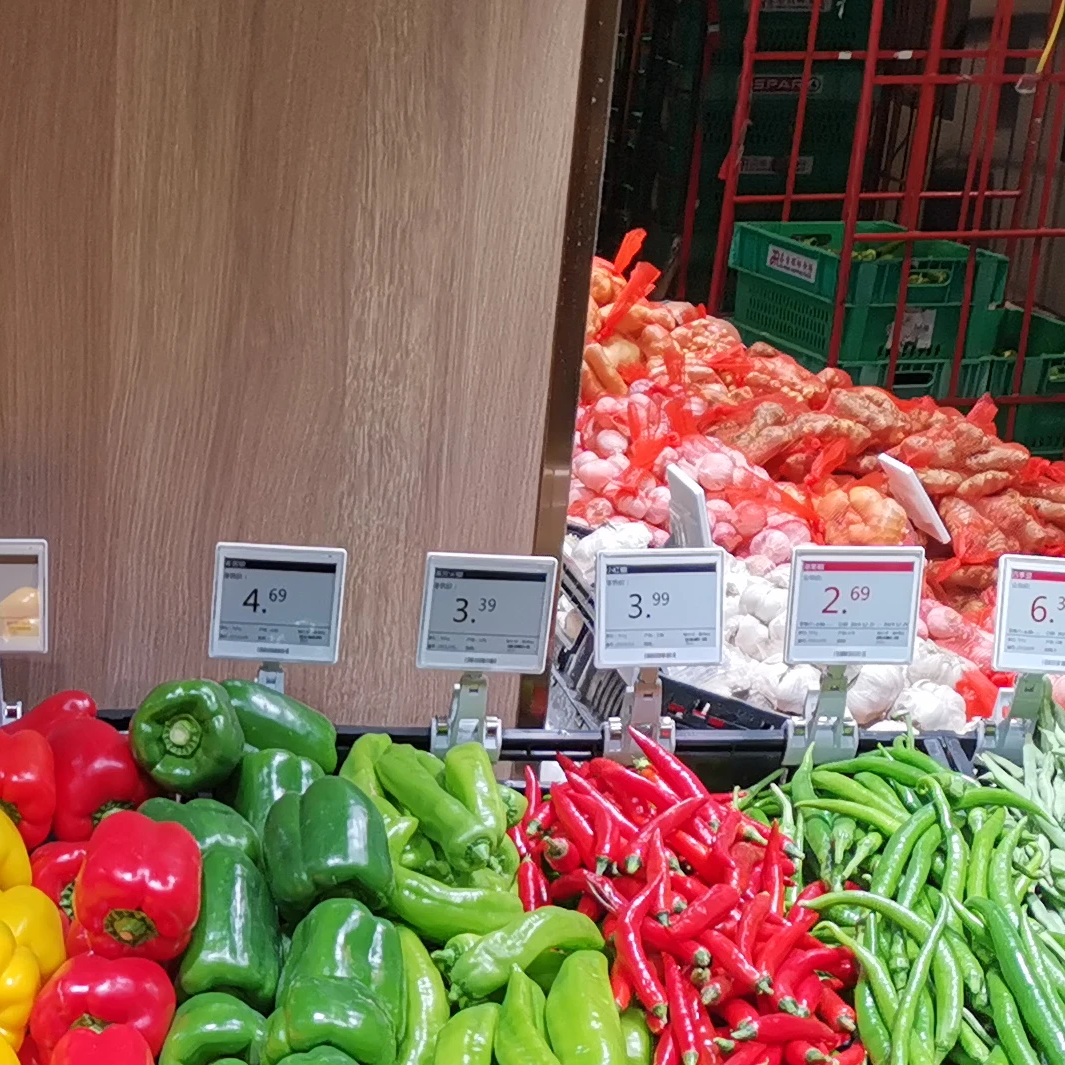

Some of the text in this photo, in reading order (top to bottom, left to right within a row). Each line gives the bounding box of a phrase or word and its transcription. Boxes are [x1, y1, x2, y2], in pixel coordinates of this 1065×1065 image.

[242, 587, 288, 614] 4.69
[452, 597, 497, 624] 3.39
[628, 591, 670, 619] 3.99
[821, 585, 871, 614] 2.69
